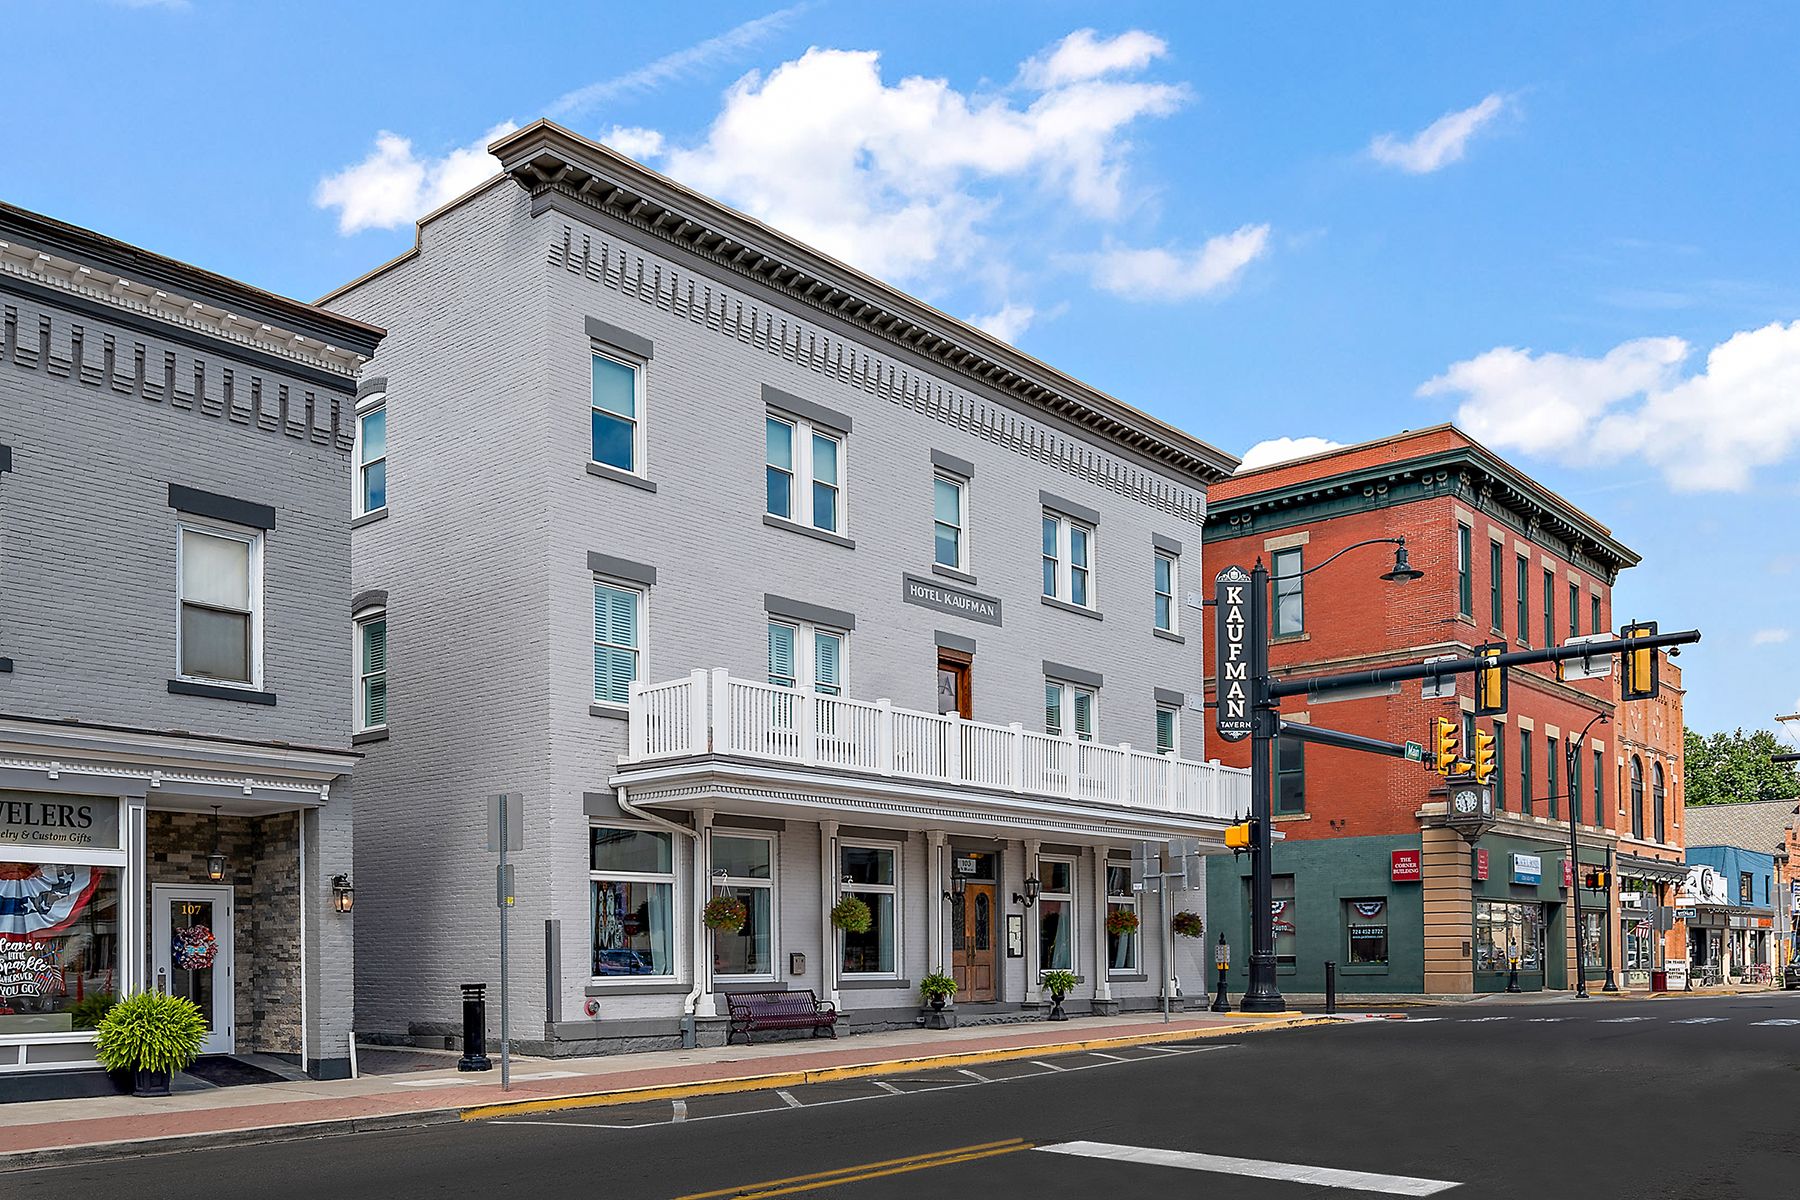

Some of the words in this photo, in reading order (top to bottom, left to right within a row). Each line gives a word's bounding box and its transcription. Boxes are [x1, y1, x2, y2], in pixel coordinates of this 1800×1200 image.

[910, 585, 942, 602] HOTEL
[944, 594, 994, 616] KAUFMAN
[1225, 586, 1247, 718] KAUFMAN
[1406, 744, 1419, 757] Main
[0, 800, 93, 829] ELERS
[21, 830, 30, 839] &
[32, 830, 67, 842] Custom
[69, 832, 92, 844] Gifts
[1393, 867, 1419, 875] BUILDING
[181, 904, 202, 915] 107
[34, 941, 45, 951] a
[0, 984, 19, 997] YOU
[21, 983, 34, 994] GO
